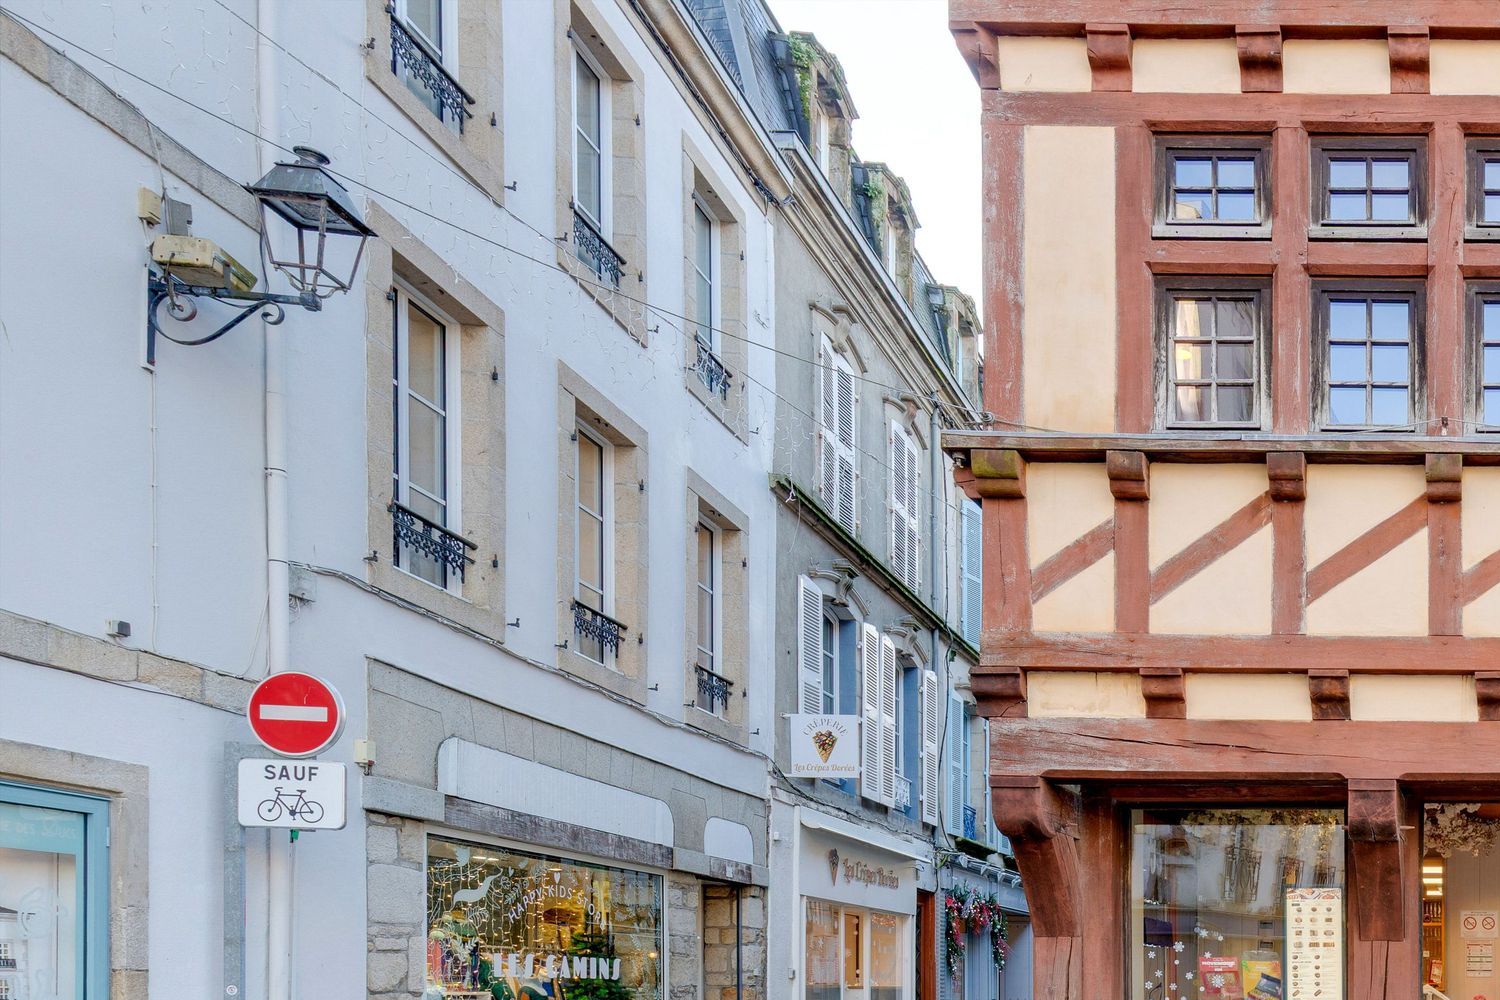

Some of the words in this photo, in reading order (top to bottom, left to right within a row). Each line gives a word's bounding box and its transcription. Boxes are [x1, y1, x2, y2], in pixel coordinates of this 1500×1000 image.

[264, 764, 319, 781] SAUF
[508, 888, 544, 924] HAPPY
[548, 885, 573, 900] KIDS
[493, 953, 535, 978] LES
